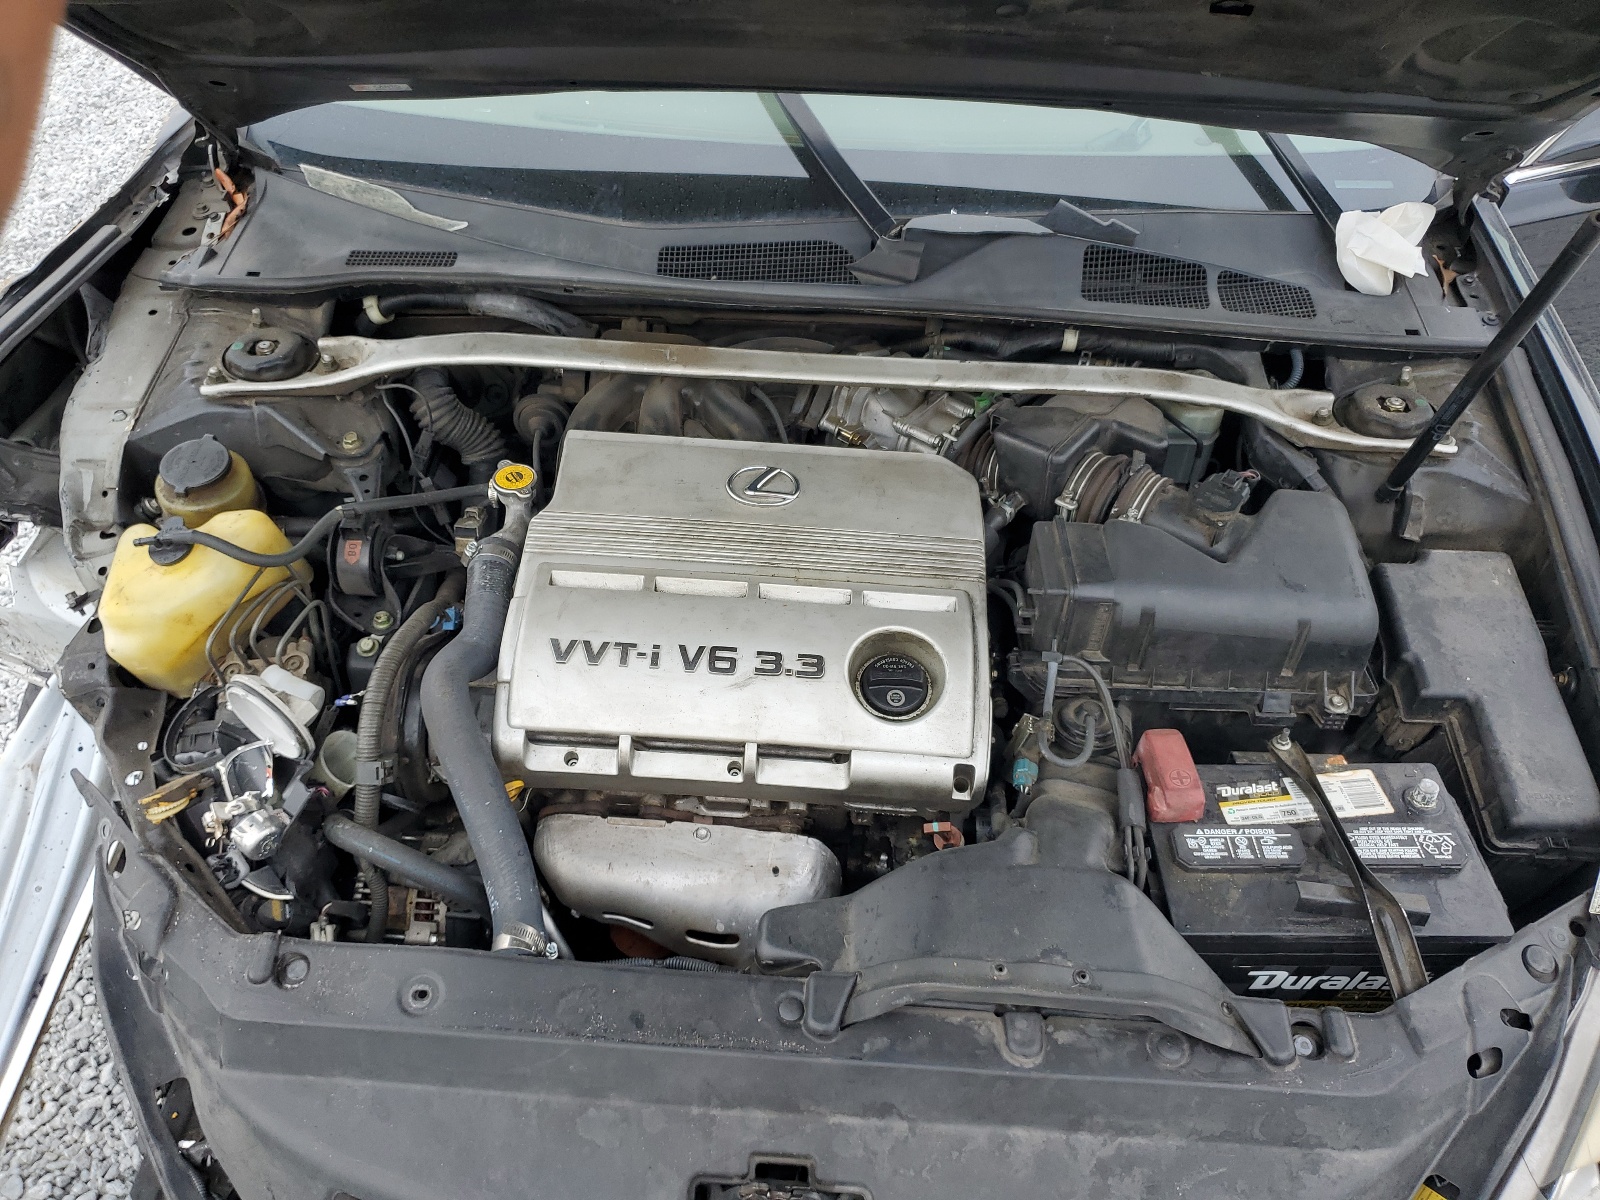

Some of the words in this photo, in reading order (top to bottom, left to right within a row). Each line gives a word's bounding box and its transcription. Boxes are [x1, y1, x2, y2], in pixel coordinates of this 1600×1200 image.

[549, 637, 661, 669] VVT-i
[678, 643, 738, 675] V6
[754, 649, 826, 679] 3.3
[1217, 781, 1279, 797] Duralast
[1282, 809, 1297, 817] 750
[1247, 970, 1391, 990] Durala
